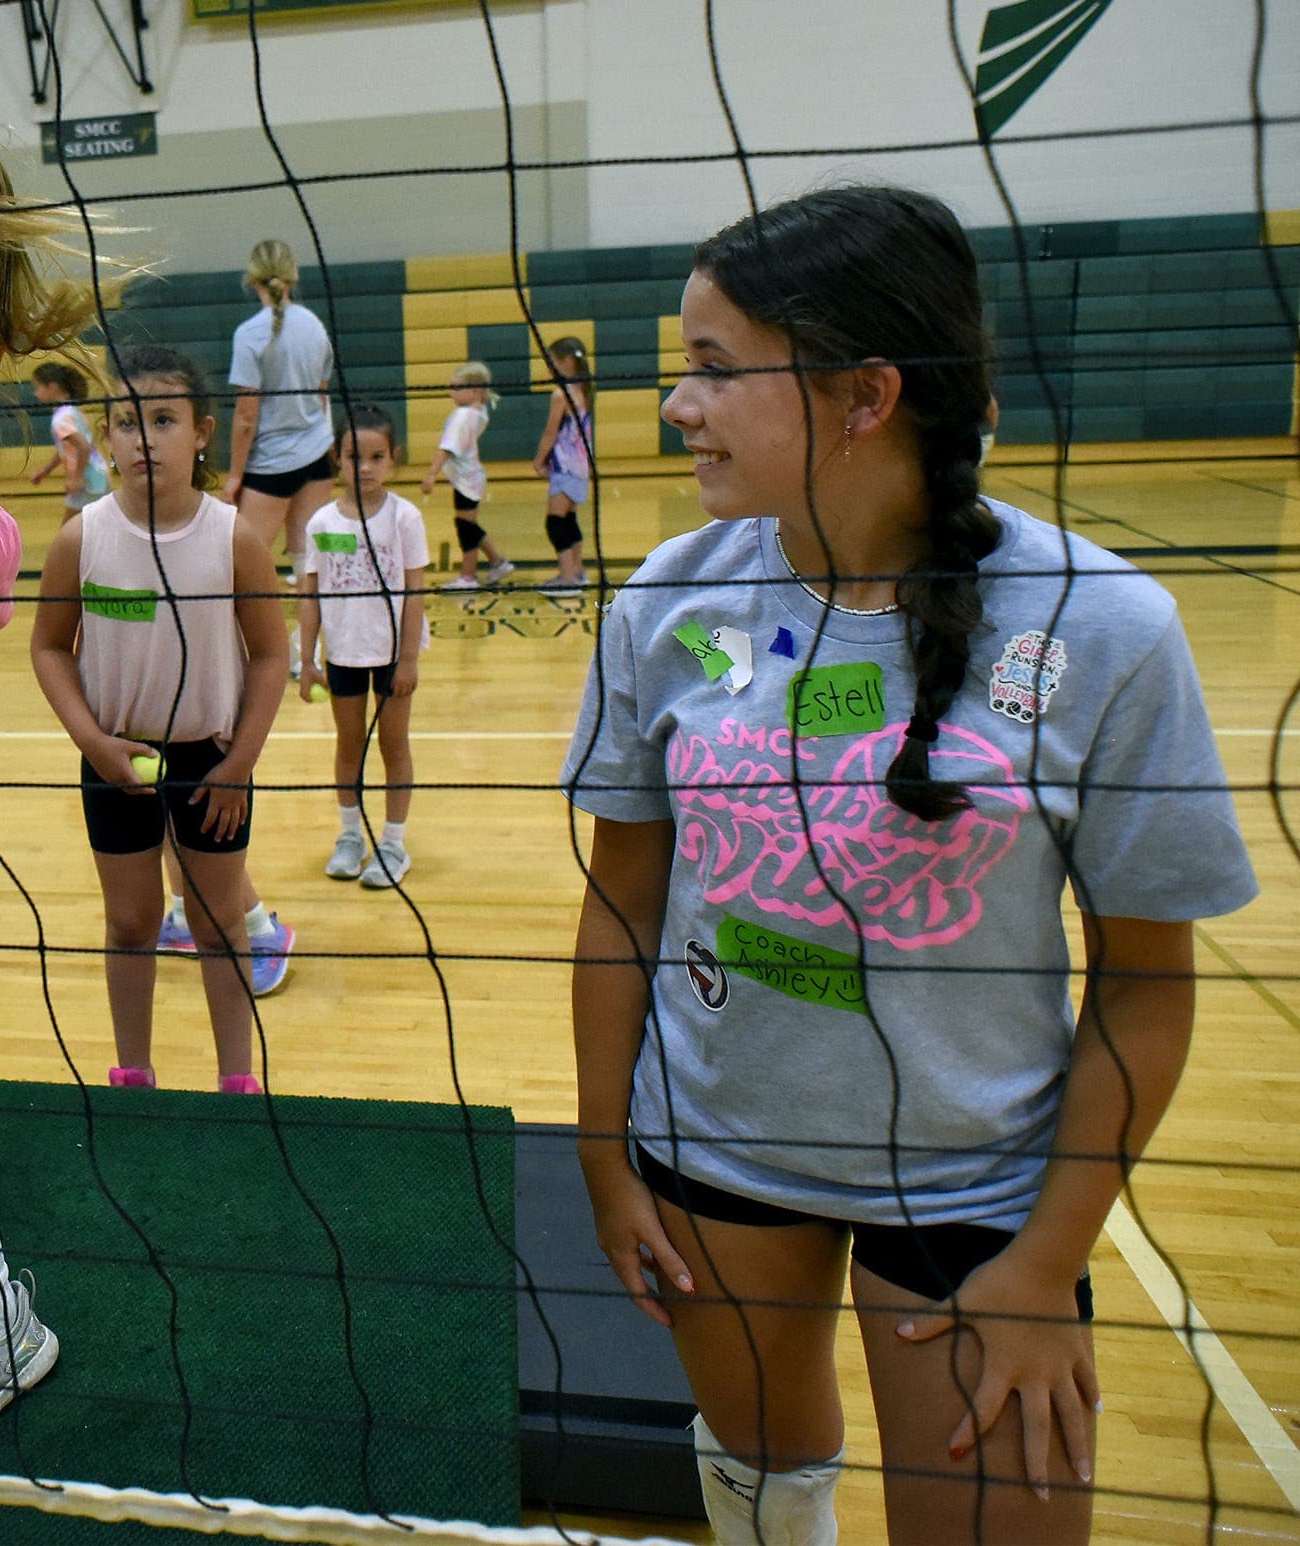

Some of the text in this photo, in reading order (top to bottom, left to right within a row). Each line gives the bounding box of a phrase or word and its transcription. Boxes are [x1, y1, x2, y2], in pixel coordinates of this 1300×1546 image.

[65, 138, 135, 157] SEATING
[74, 121, 121, 138] SMCC
[794, 678, 885, 727] Estell
[716, 718, 820, 761] SMCC
[734, 924, 826, 969] Coach
[734, 948, 831, 999] Ashley
